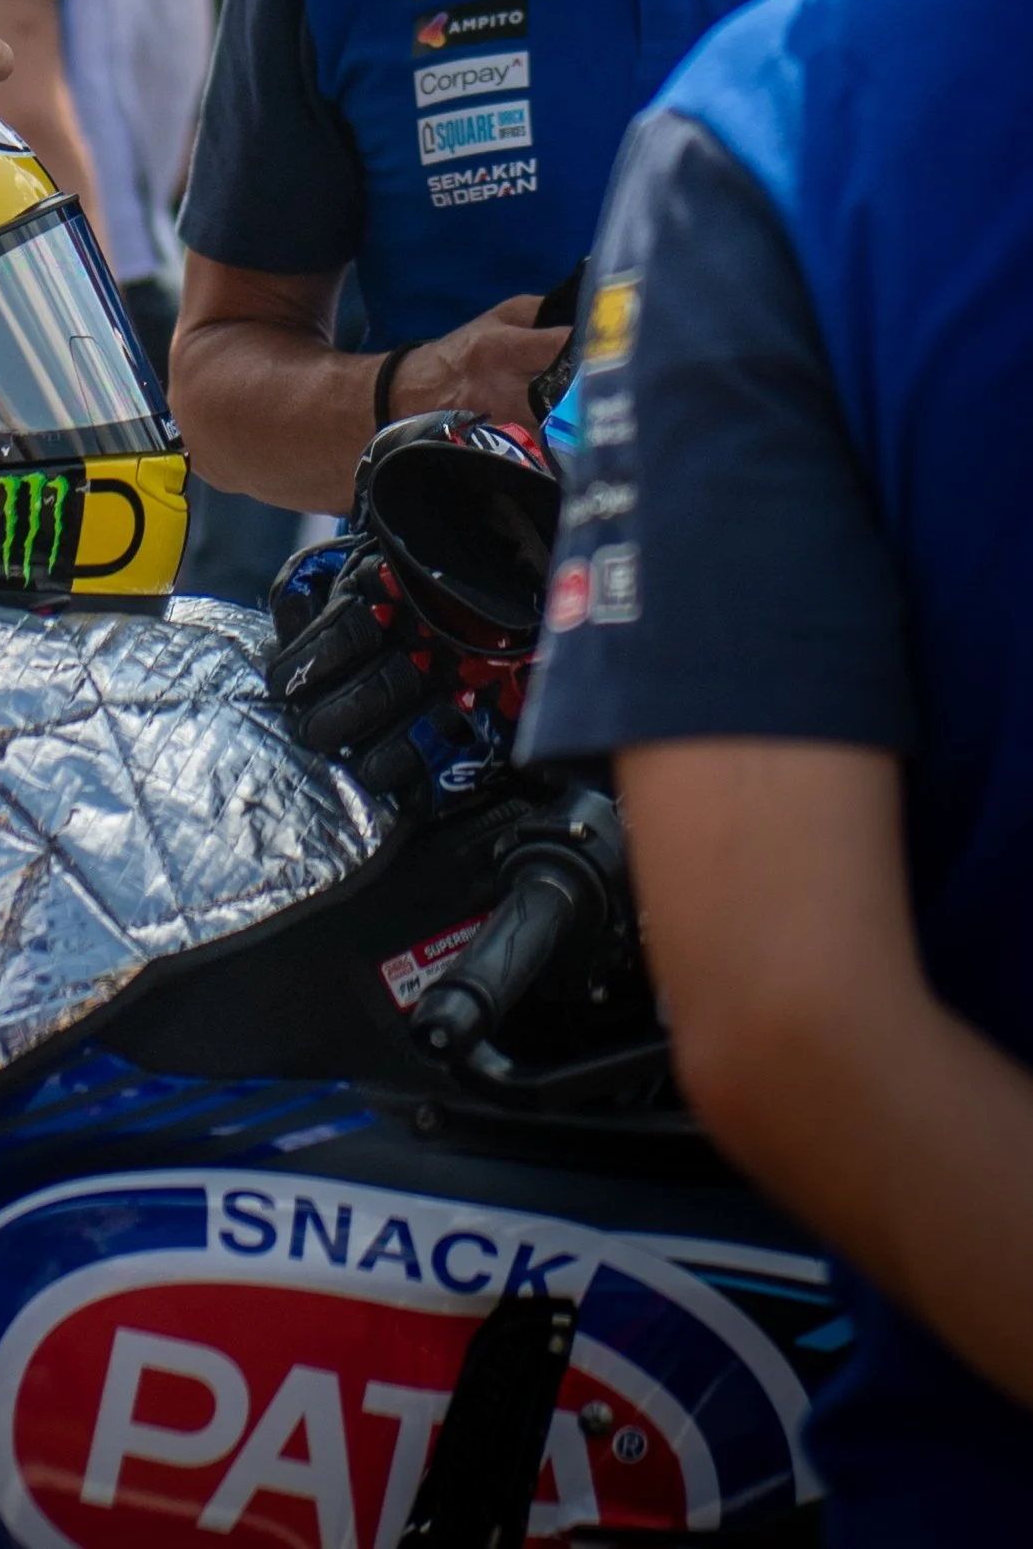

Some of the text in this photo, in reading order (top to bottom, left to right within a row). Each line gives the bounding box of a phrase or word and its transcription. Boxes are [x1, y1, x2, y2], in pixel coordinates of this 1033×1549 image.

[449, 10, 524, 35] AMPITO
[420, 64, 511, 96] Corpay
[435, 112, 497, 155] SQUARE
[453, 175, 538, 206] DEPAN
[219, 1191, 579, 1300] SNACK
